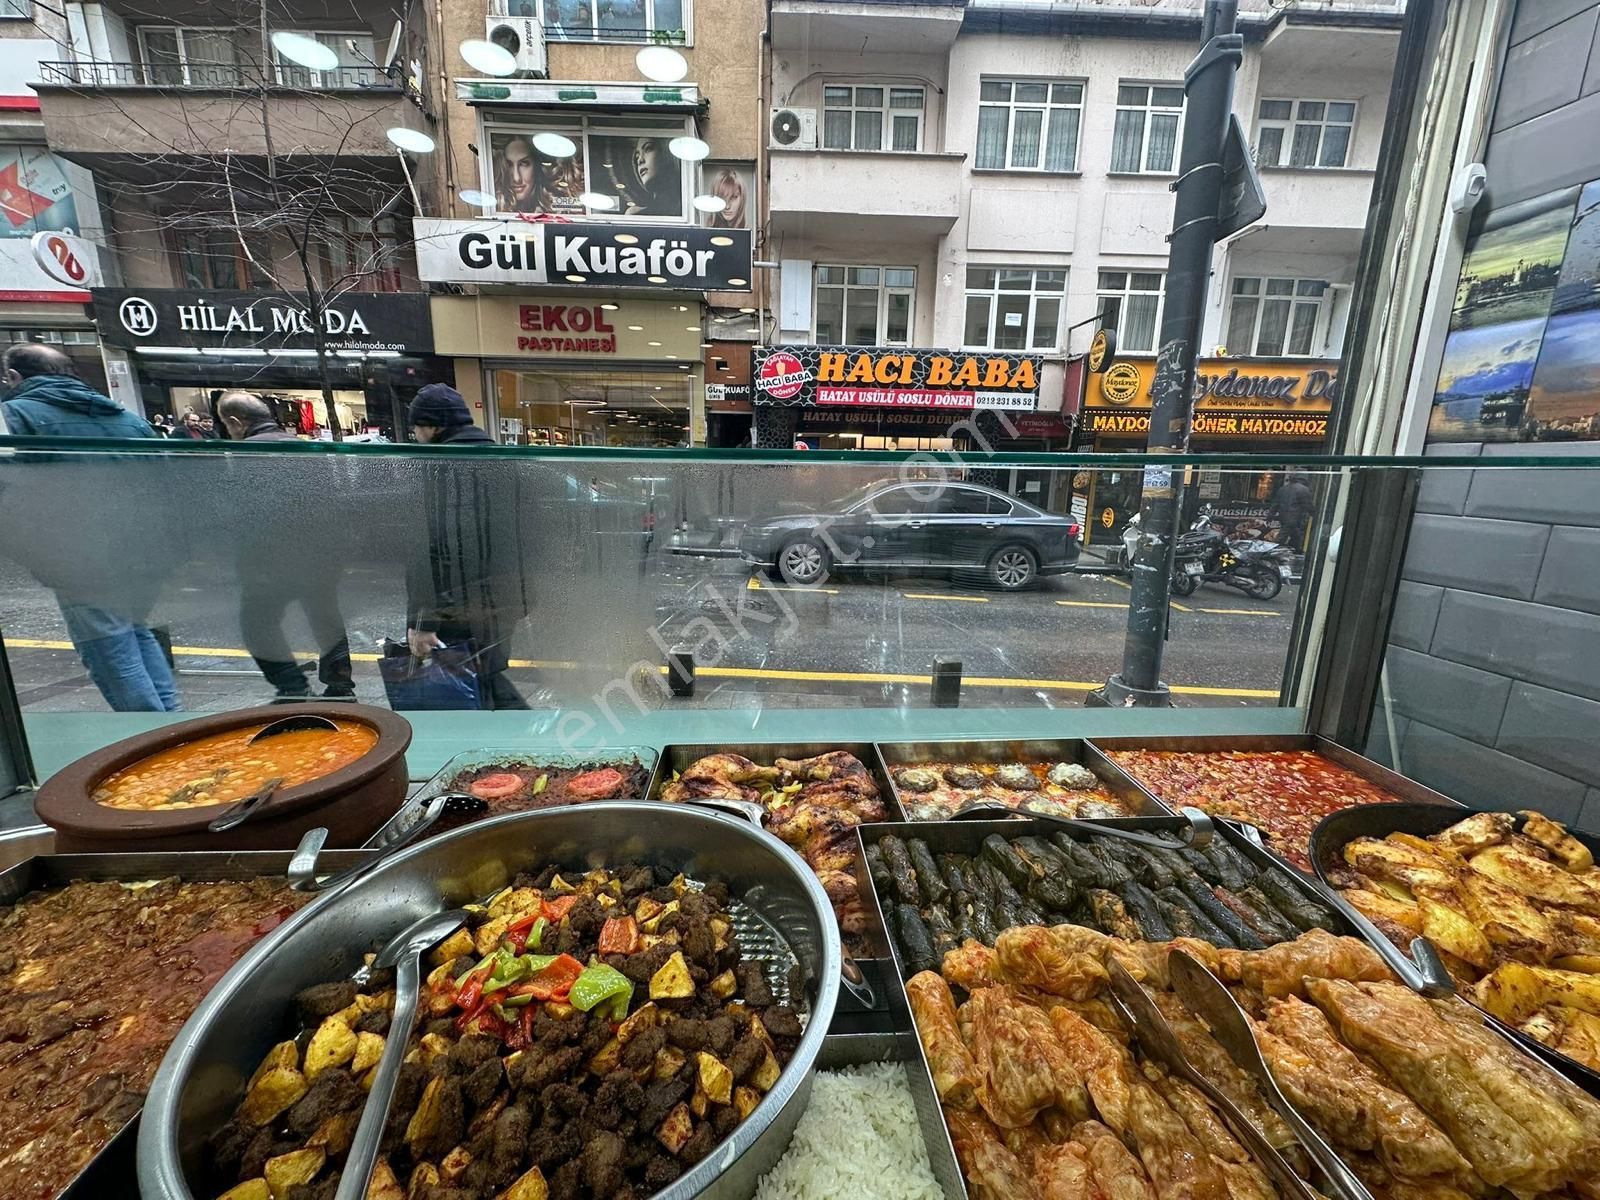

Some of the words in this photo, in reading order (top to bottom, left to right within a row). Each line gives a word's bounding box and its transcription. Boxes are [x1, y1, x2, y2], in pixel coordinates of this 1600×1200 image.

[525, 19, 533, 48] arçelik
[459, 233, 537, 271] Gül
[554, 234, 715, 278] Kuaför
[177, 298, 264, 333] HİLAL
[519, 304, 614, 333] EKOL
[517, 334, 617, 353] PASTANESİ
[757, 377, 783, 389] HACI
[784, 372, 811, 385] BABA
[816, 353, 918, 385] HACI
[926, 356, 1038, 389] BABA
[819, 389, 857, 403] HATAY
[858, 390, 896, 405] USÜLÜ
[896, 392, 933, 406] SOSLU
[934, 394, 973, 407] DÖNER
[976, 396, 996, 405] 0212
[996, 397, 1011, 406] 231
[1022, 398, 1033, 406] 52
[803, 411, 843, 422] HATAY
[886, 413, 924, 424] SOSLU
[1240, 418, 1327, 434] MAYDONOZ
